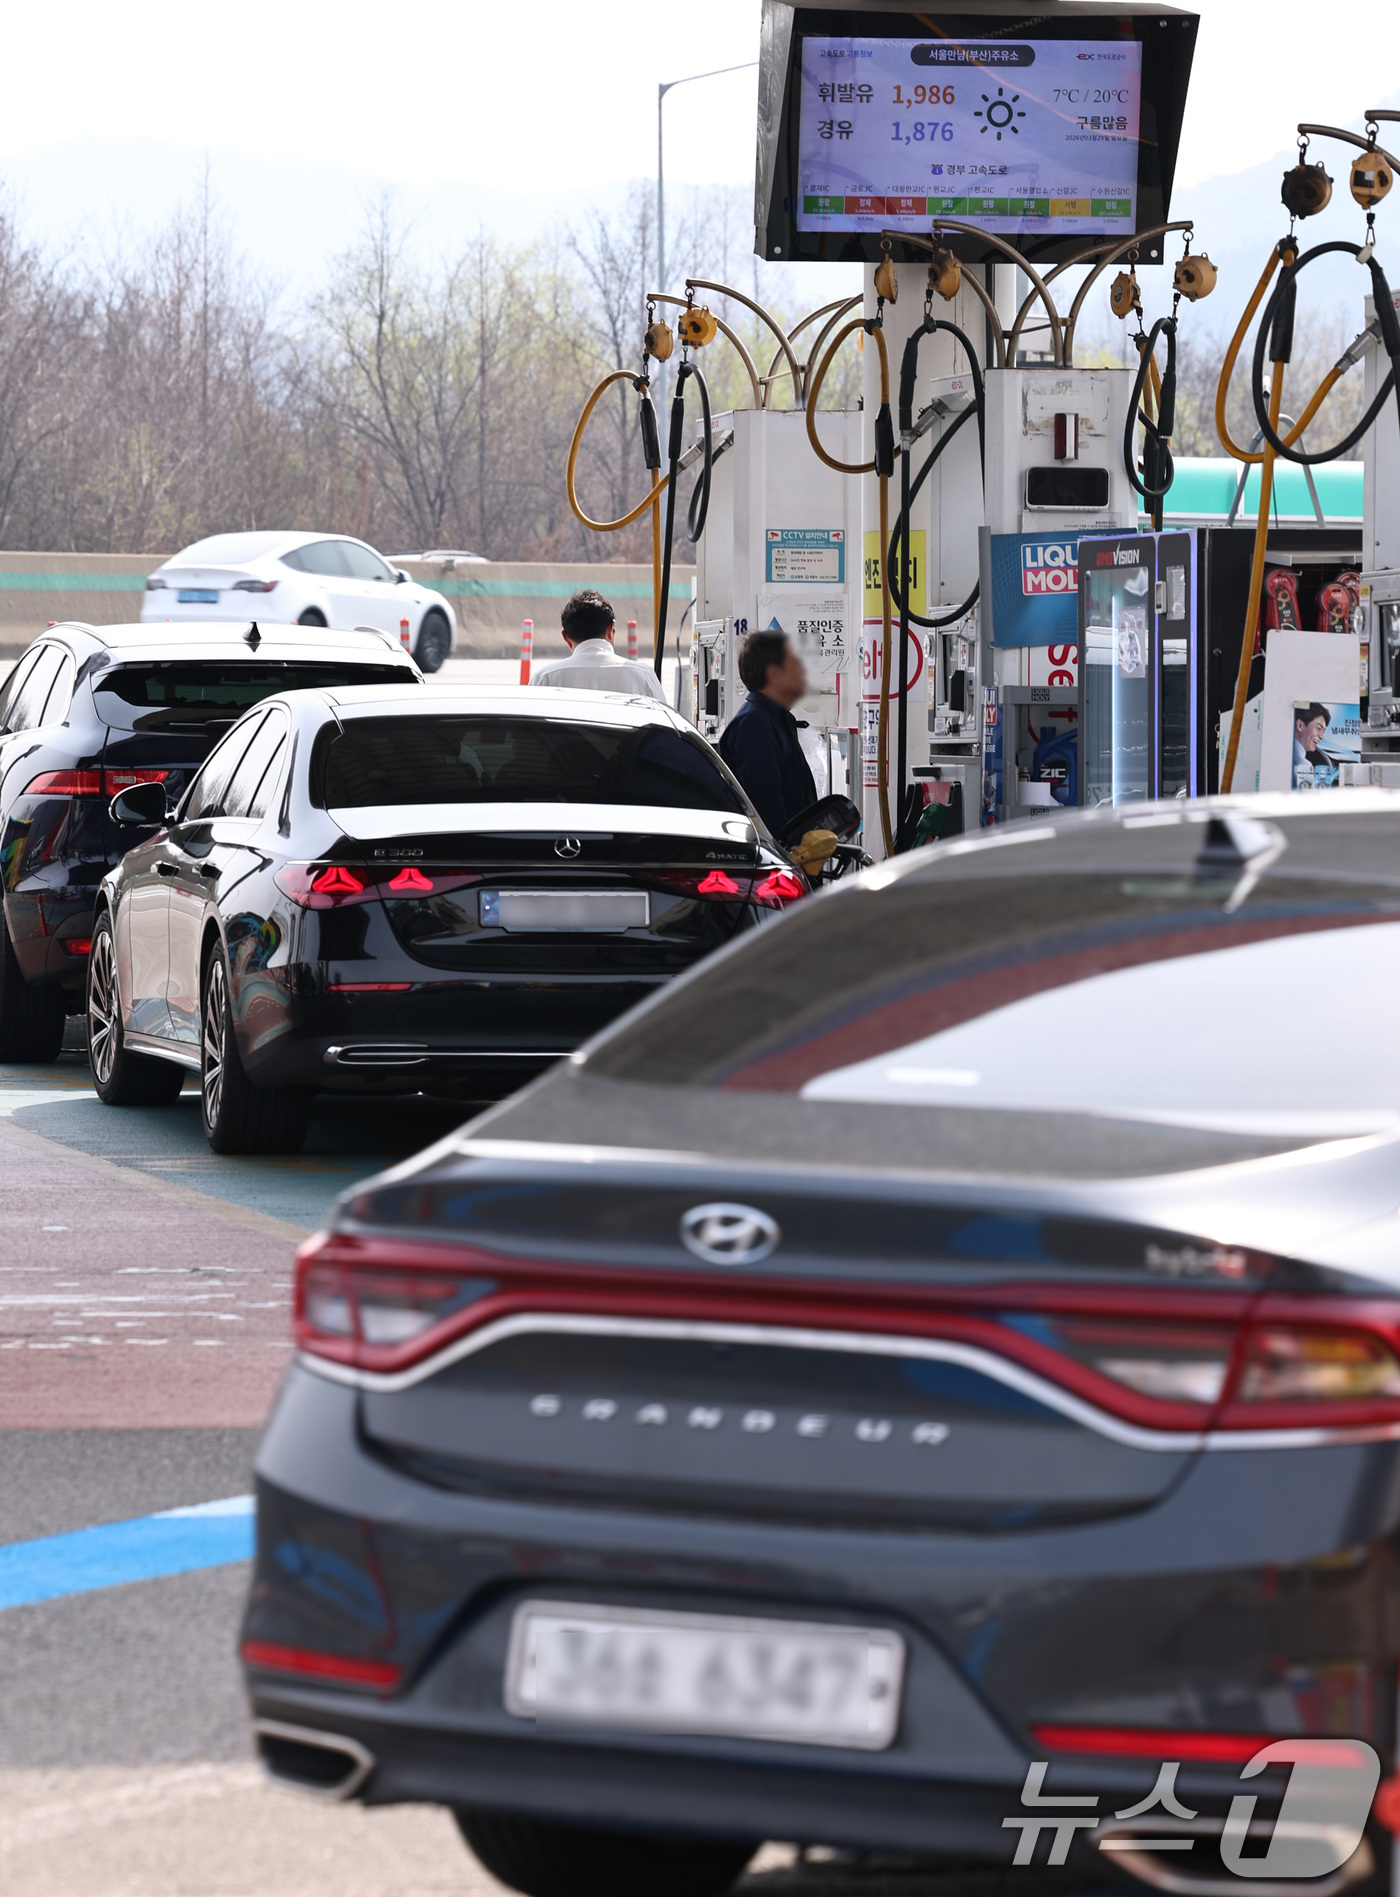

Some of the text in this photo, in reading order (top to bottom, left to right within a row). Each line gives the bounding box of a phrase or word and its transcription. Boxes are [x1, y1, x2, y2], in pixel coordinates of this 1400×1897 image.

[819, 50, 873, 58] 고속도로 교통정보
[929, 50, 1019, 62] 서울만남(부산)주유소
[818, 83, 955, 109] 휘발유 1,986
[1076, 116, 1128, 130] 구름많음
[817, 120, 954, 146] 경유 1,876
[947, 164, 966, 175] 경부
[968, 165, 1008, 176] 고속도로
[974, 186, 995, 194] 판교IC
[783, 531, 804, 539] CCTV
[1026, 545, 1078, 567] LIQU
[1027, 570, 1078, 592] MOL
[734, 618, 748, 636] 18
[797, 620, 844, 633] 품질인증
[1040, 768, 1066, 778] ZIC
[529, 1392, 950, 1447] GRANDEUR
